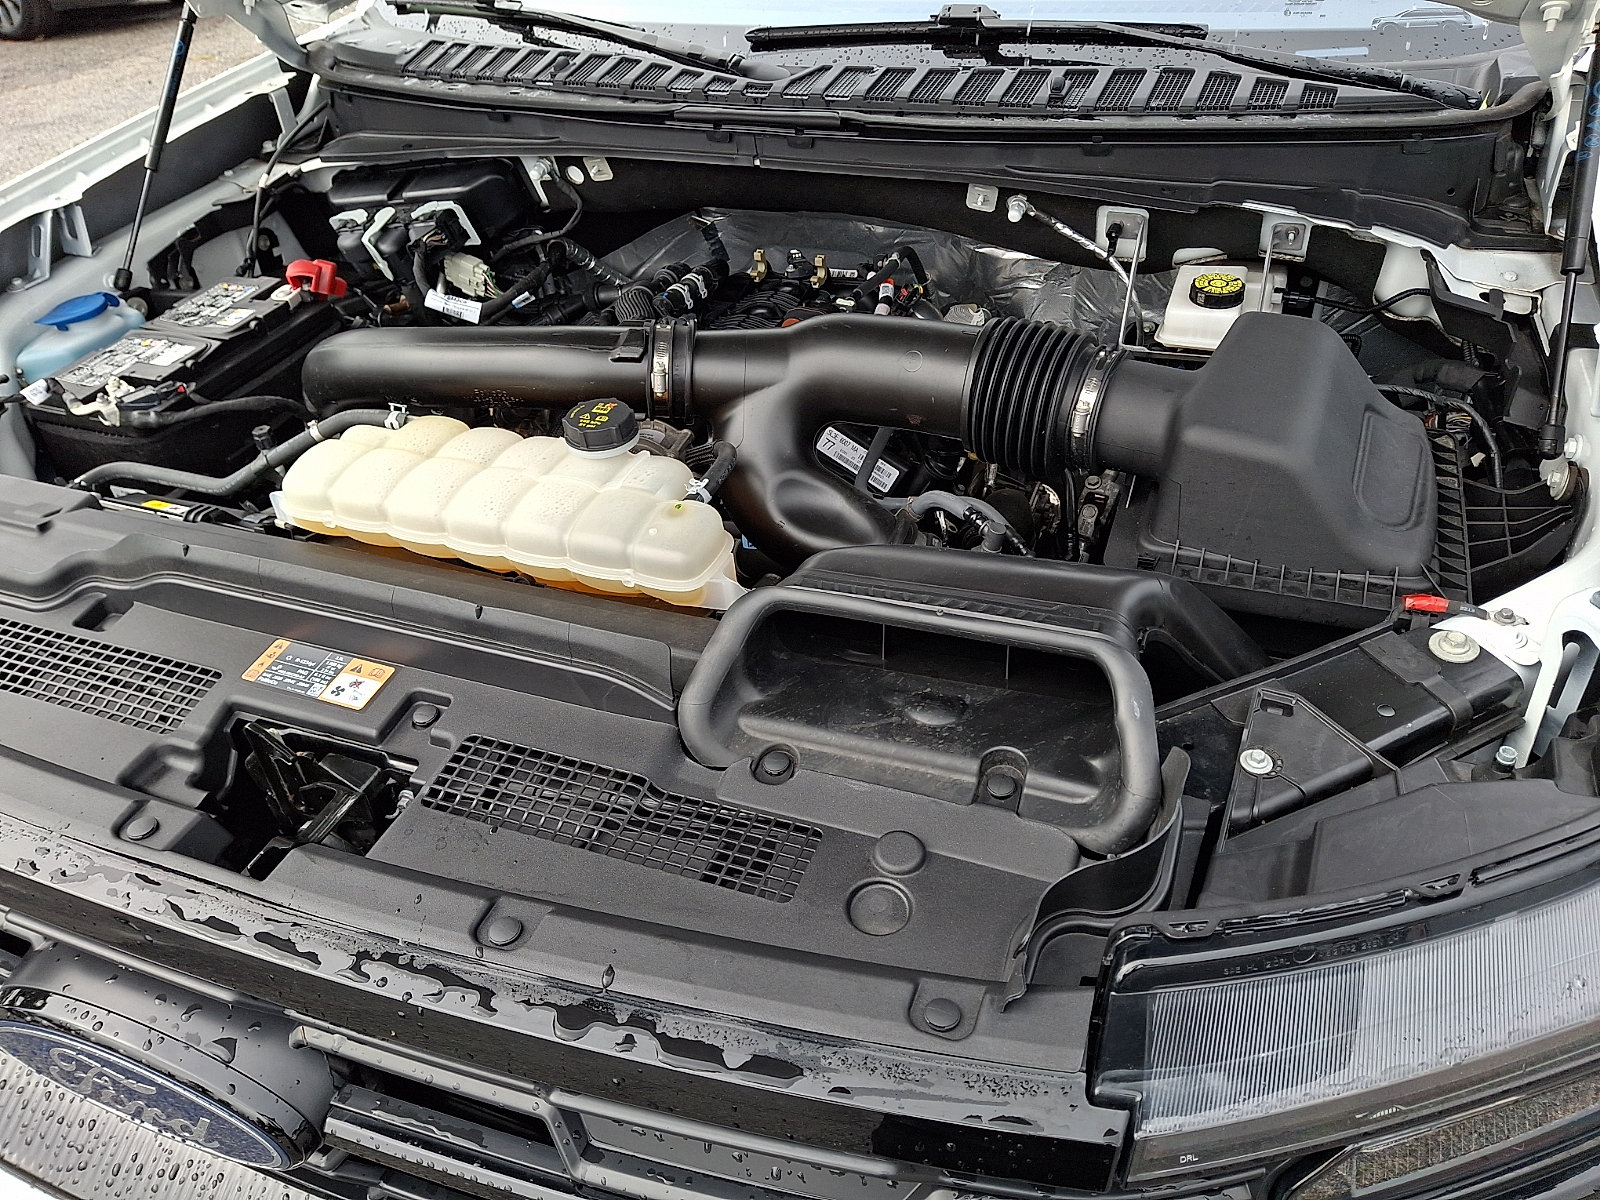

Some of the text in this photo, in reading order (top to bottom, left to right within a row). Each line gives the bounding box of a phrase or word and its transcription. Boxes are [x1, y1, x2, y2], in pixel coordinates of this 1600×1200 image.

[823, 438, 835, 450] 77
[48, 1046, 220, 1149] Ford
[1180, 1154, 1198, 1163] DRL
